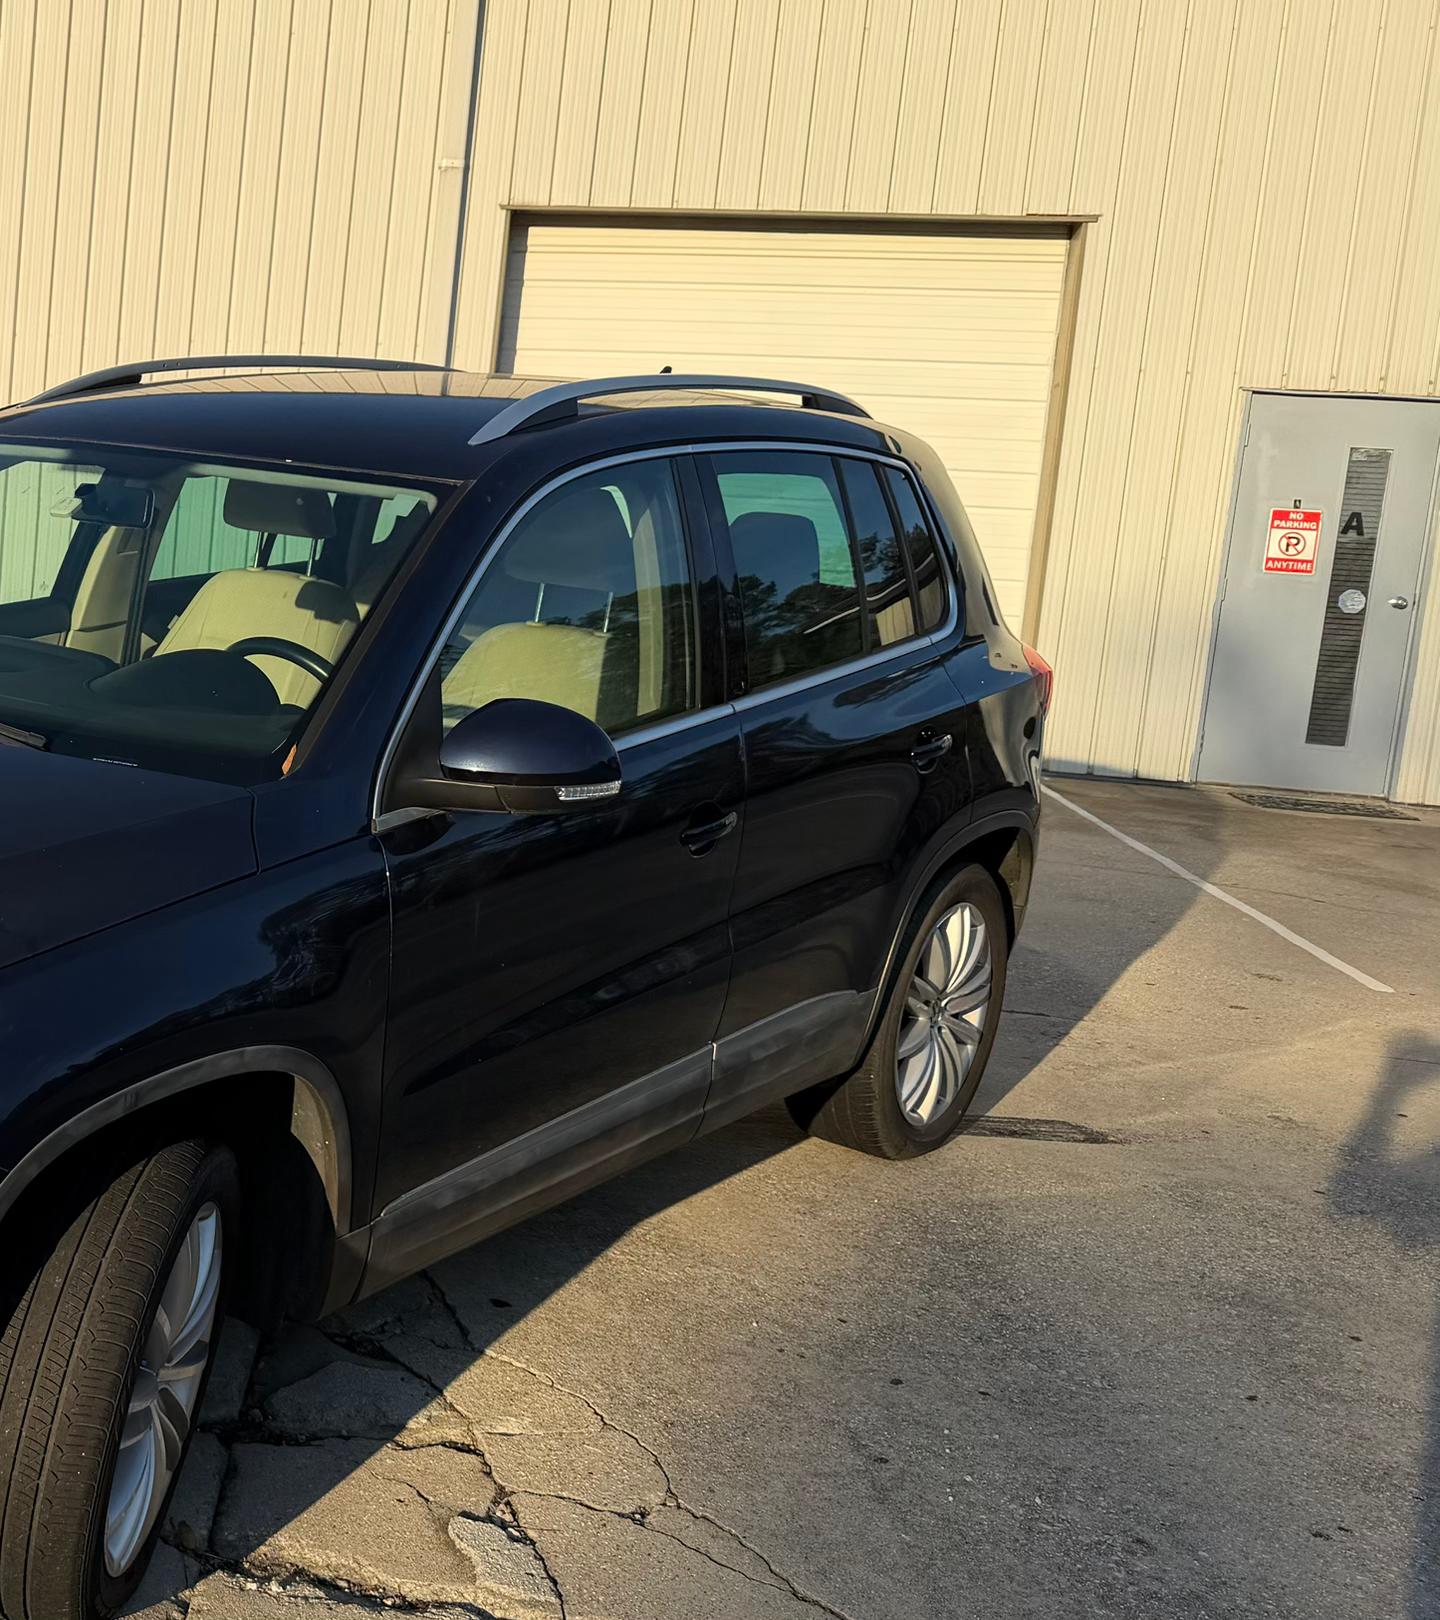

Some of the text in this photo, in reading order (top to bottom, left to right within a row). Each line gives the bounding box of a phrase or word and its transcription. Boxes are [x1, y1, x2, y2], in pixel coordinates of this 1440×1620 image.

[1289, 512, 1304, 520] NO
[1273, 519, 1317, 529] PARKING
[1340, 511, 1364, 536] A
[1266, 560, 1313, 571] ANYTIME
